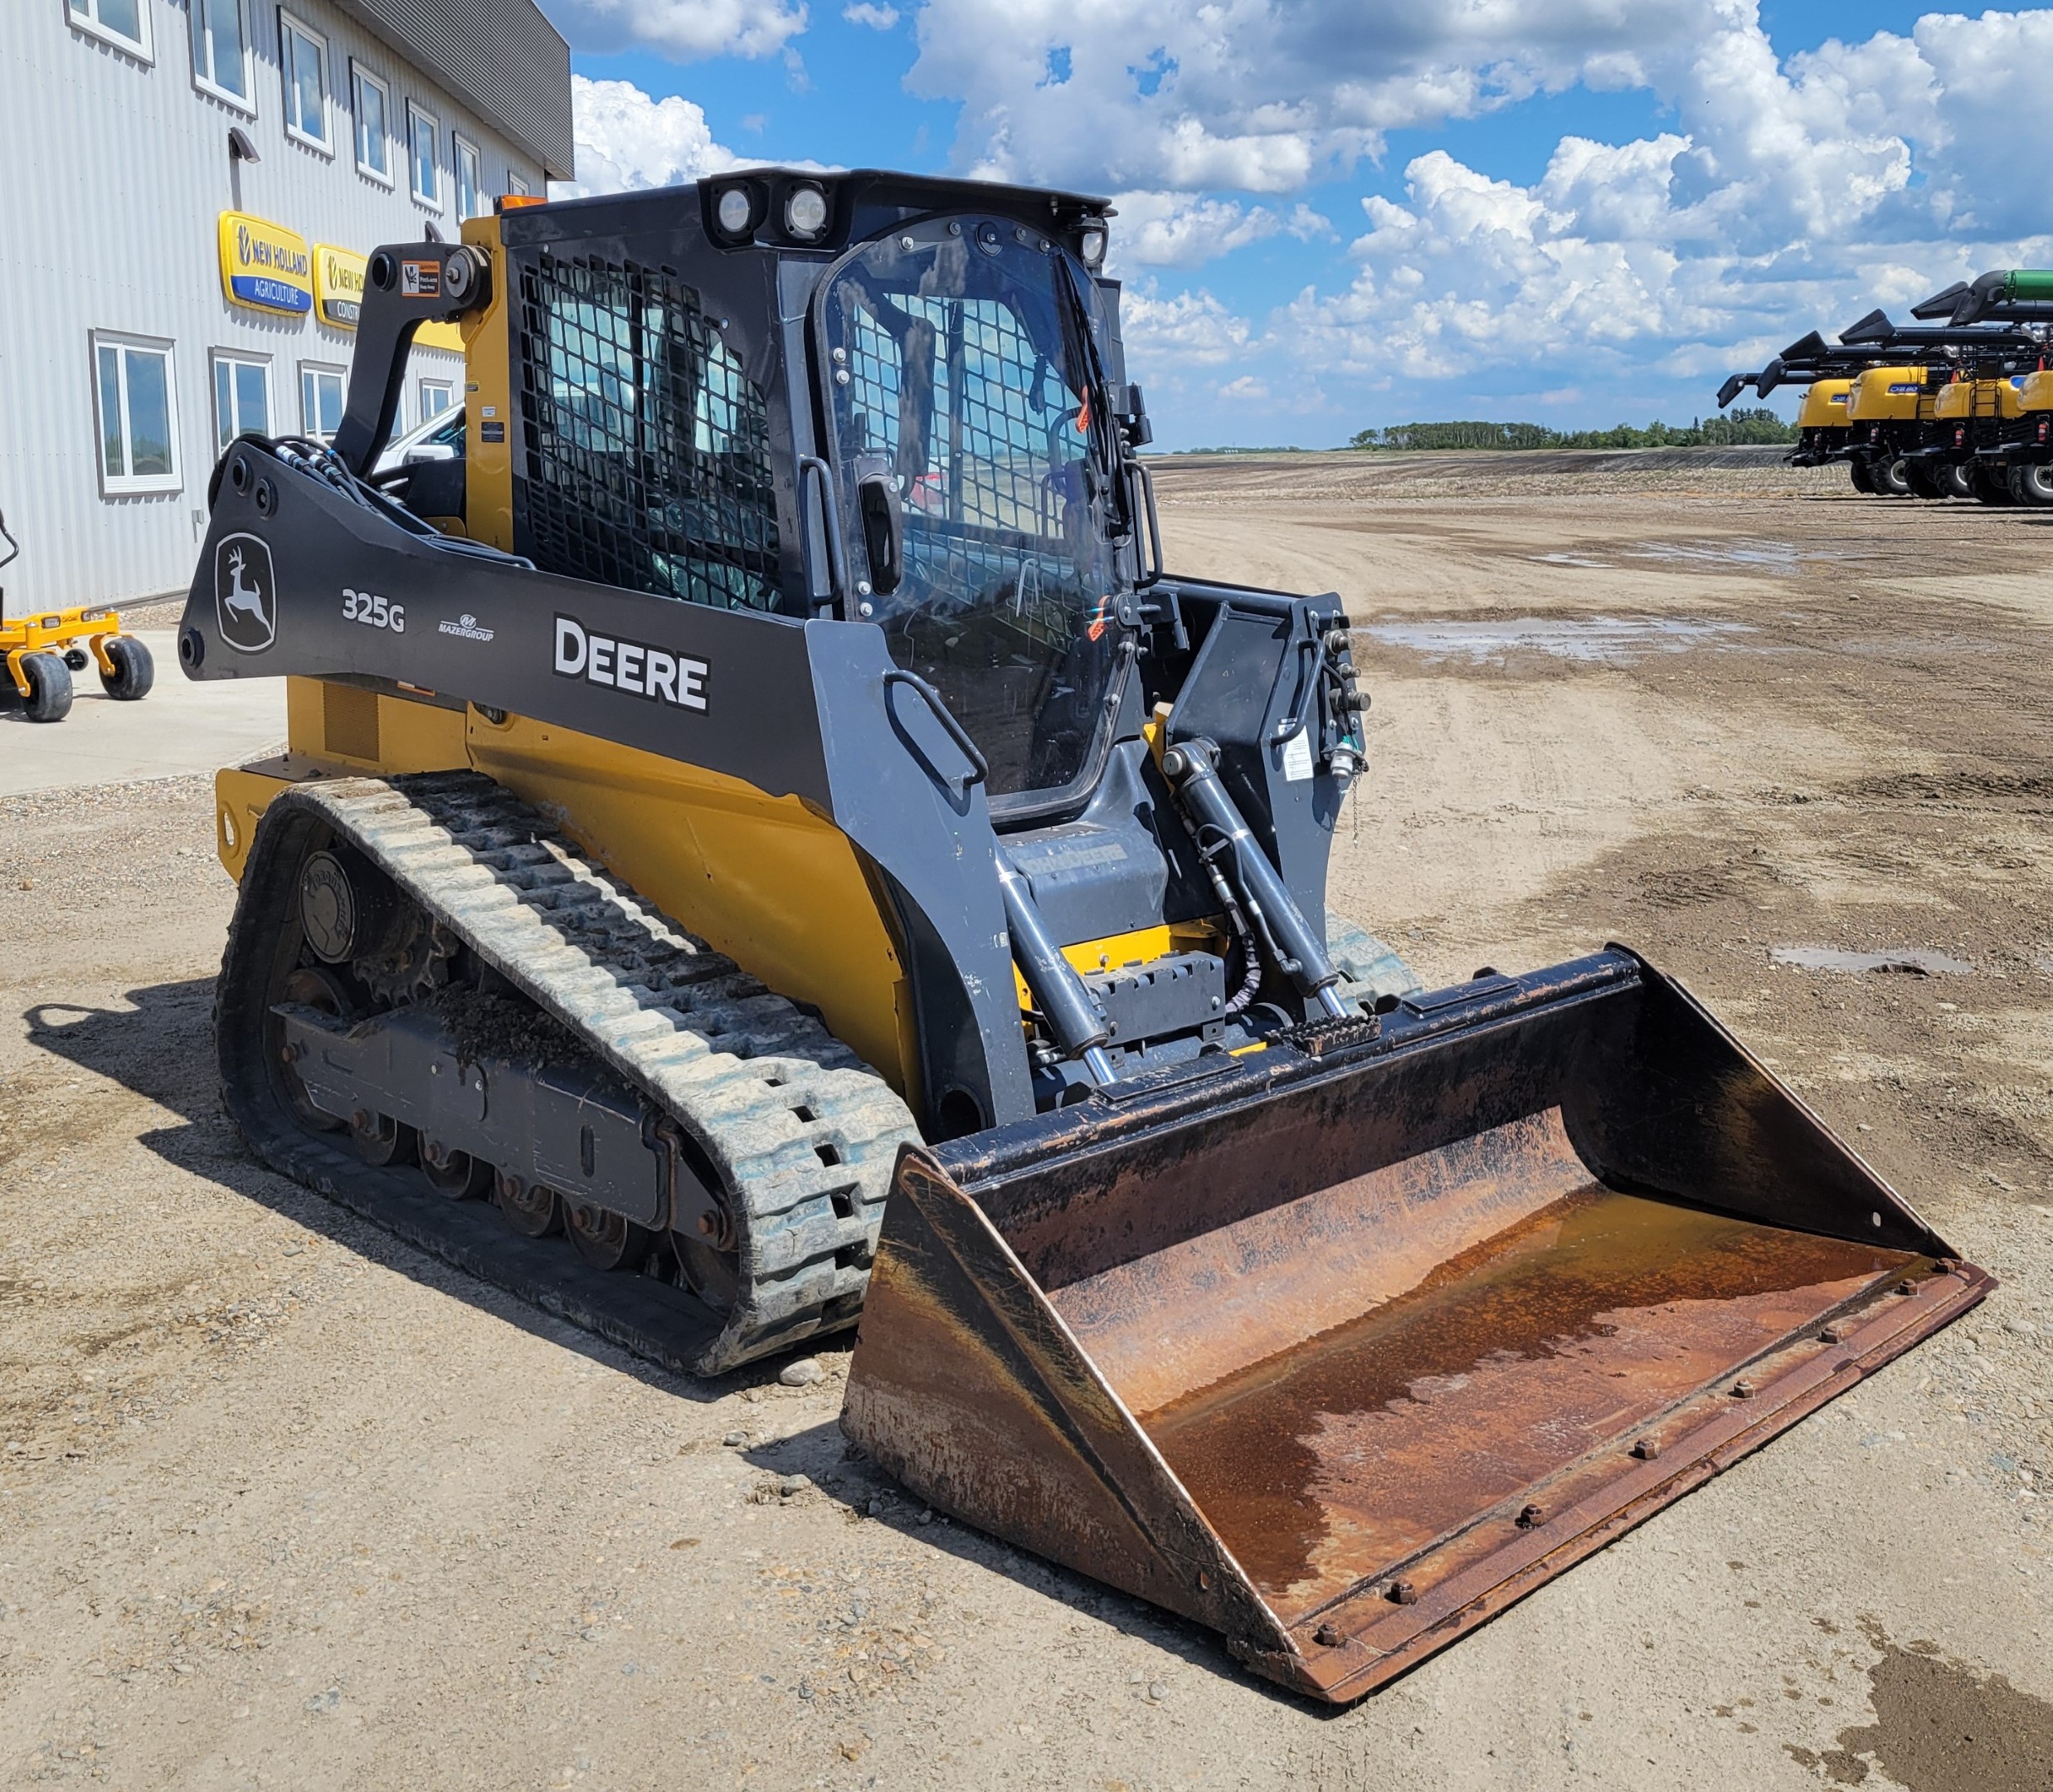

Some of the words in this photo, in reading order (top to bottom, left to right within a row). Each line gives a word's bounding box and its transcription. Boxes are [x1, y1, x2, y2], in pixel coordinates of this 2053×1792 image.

[252, 238, 272, 268] NEW
[273, 245, 308, 277] HOLLAND
[254, 279, 299, 304] AGRICULTURE
[338, 266, 353, 291] NEW
[343, 588, 405, 633] 325G
[438, 623, 494, 643] MAZERGROUP
[555, 617, 708, 710] DEERE
